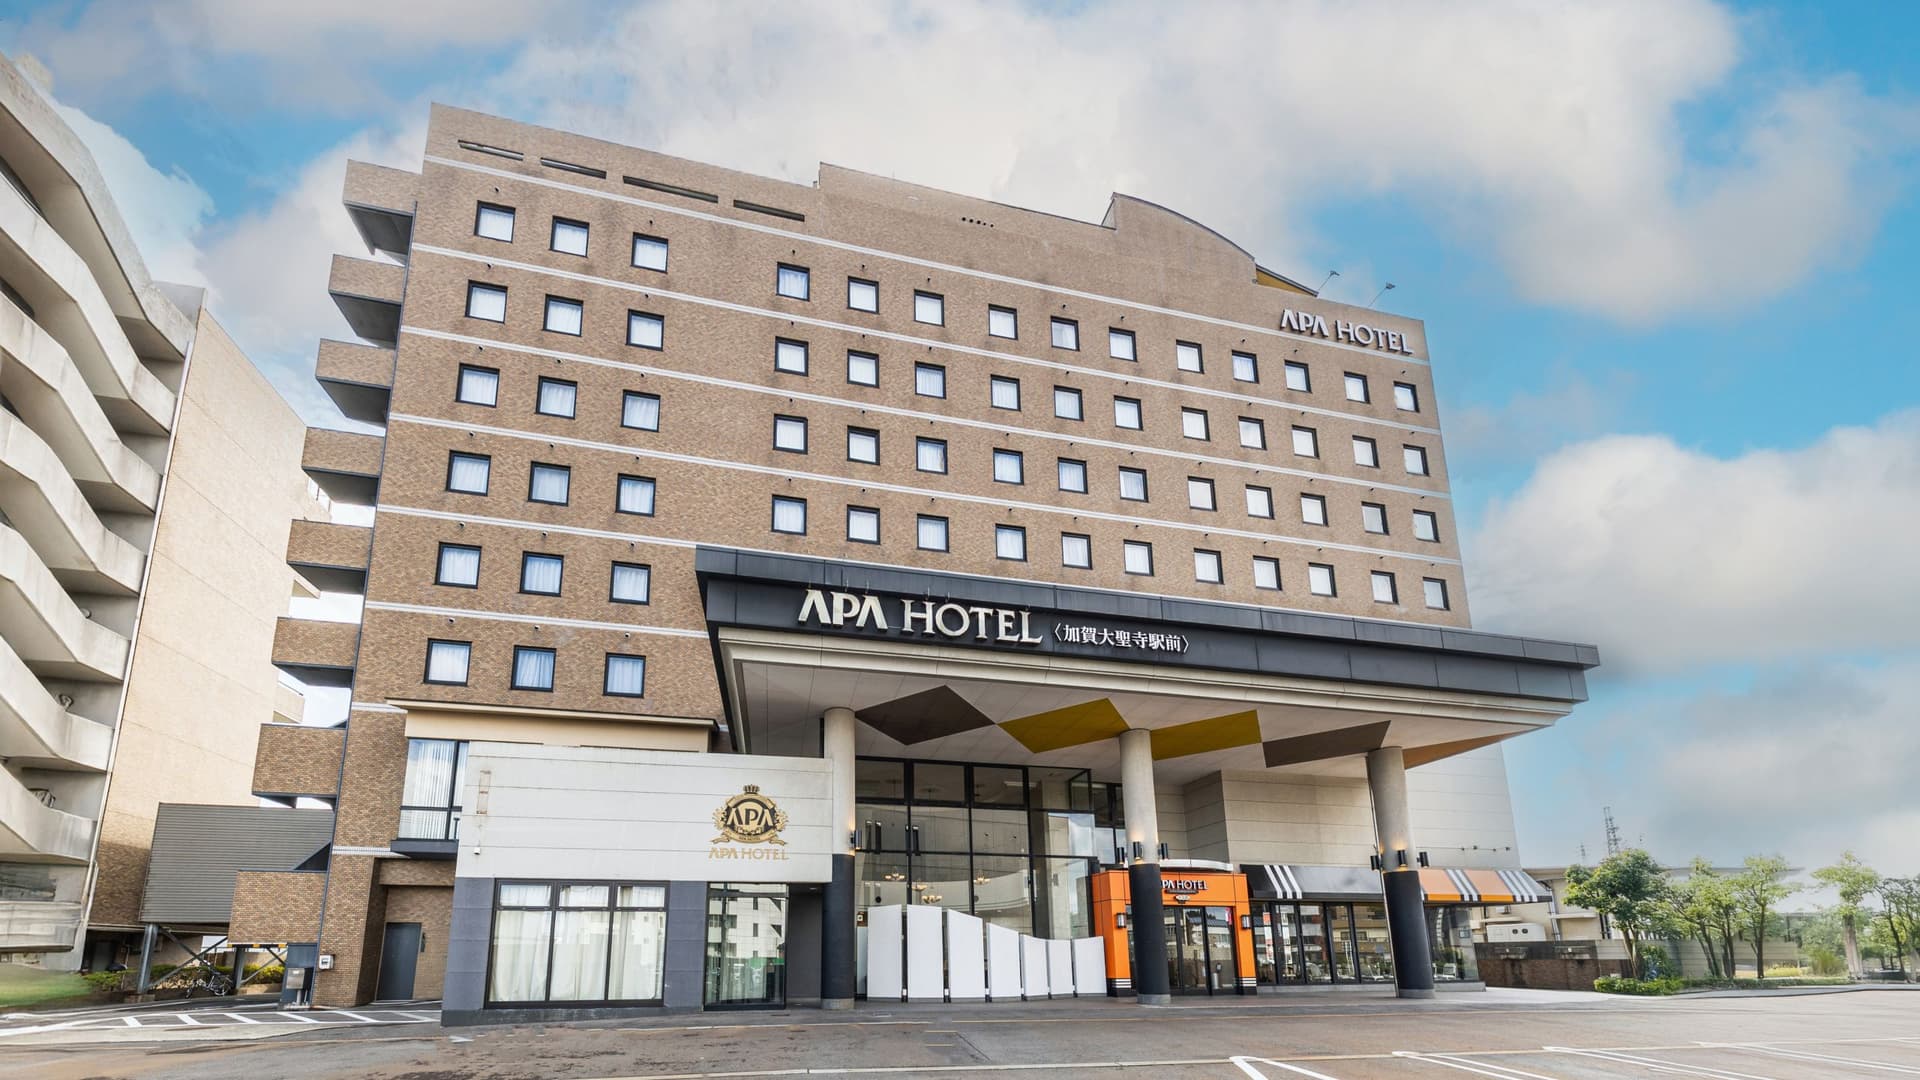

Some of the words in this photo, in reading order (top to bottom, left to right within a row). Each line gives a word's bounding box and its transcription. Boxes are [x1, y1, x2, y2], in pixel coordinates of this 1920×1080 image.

[1281, 308, 1329, 337] APA
[1336, 319, 1414, 354] HOTEL
[798, 589, 888, 631] APA
[901, 598, 1043, 644] HOTEL
[727, 808, 774, 826] APA
[708, 847, 738, 859] APA
[741, 848, 789, 860] HOTEL
[1161, 879, 1175, 889] PA
[1176, 880, 1208, 890] HOTEL
